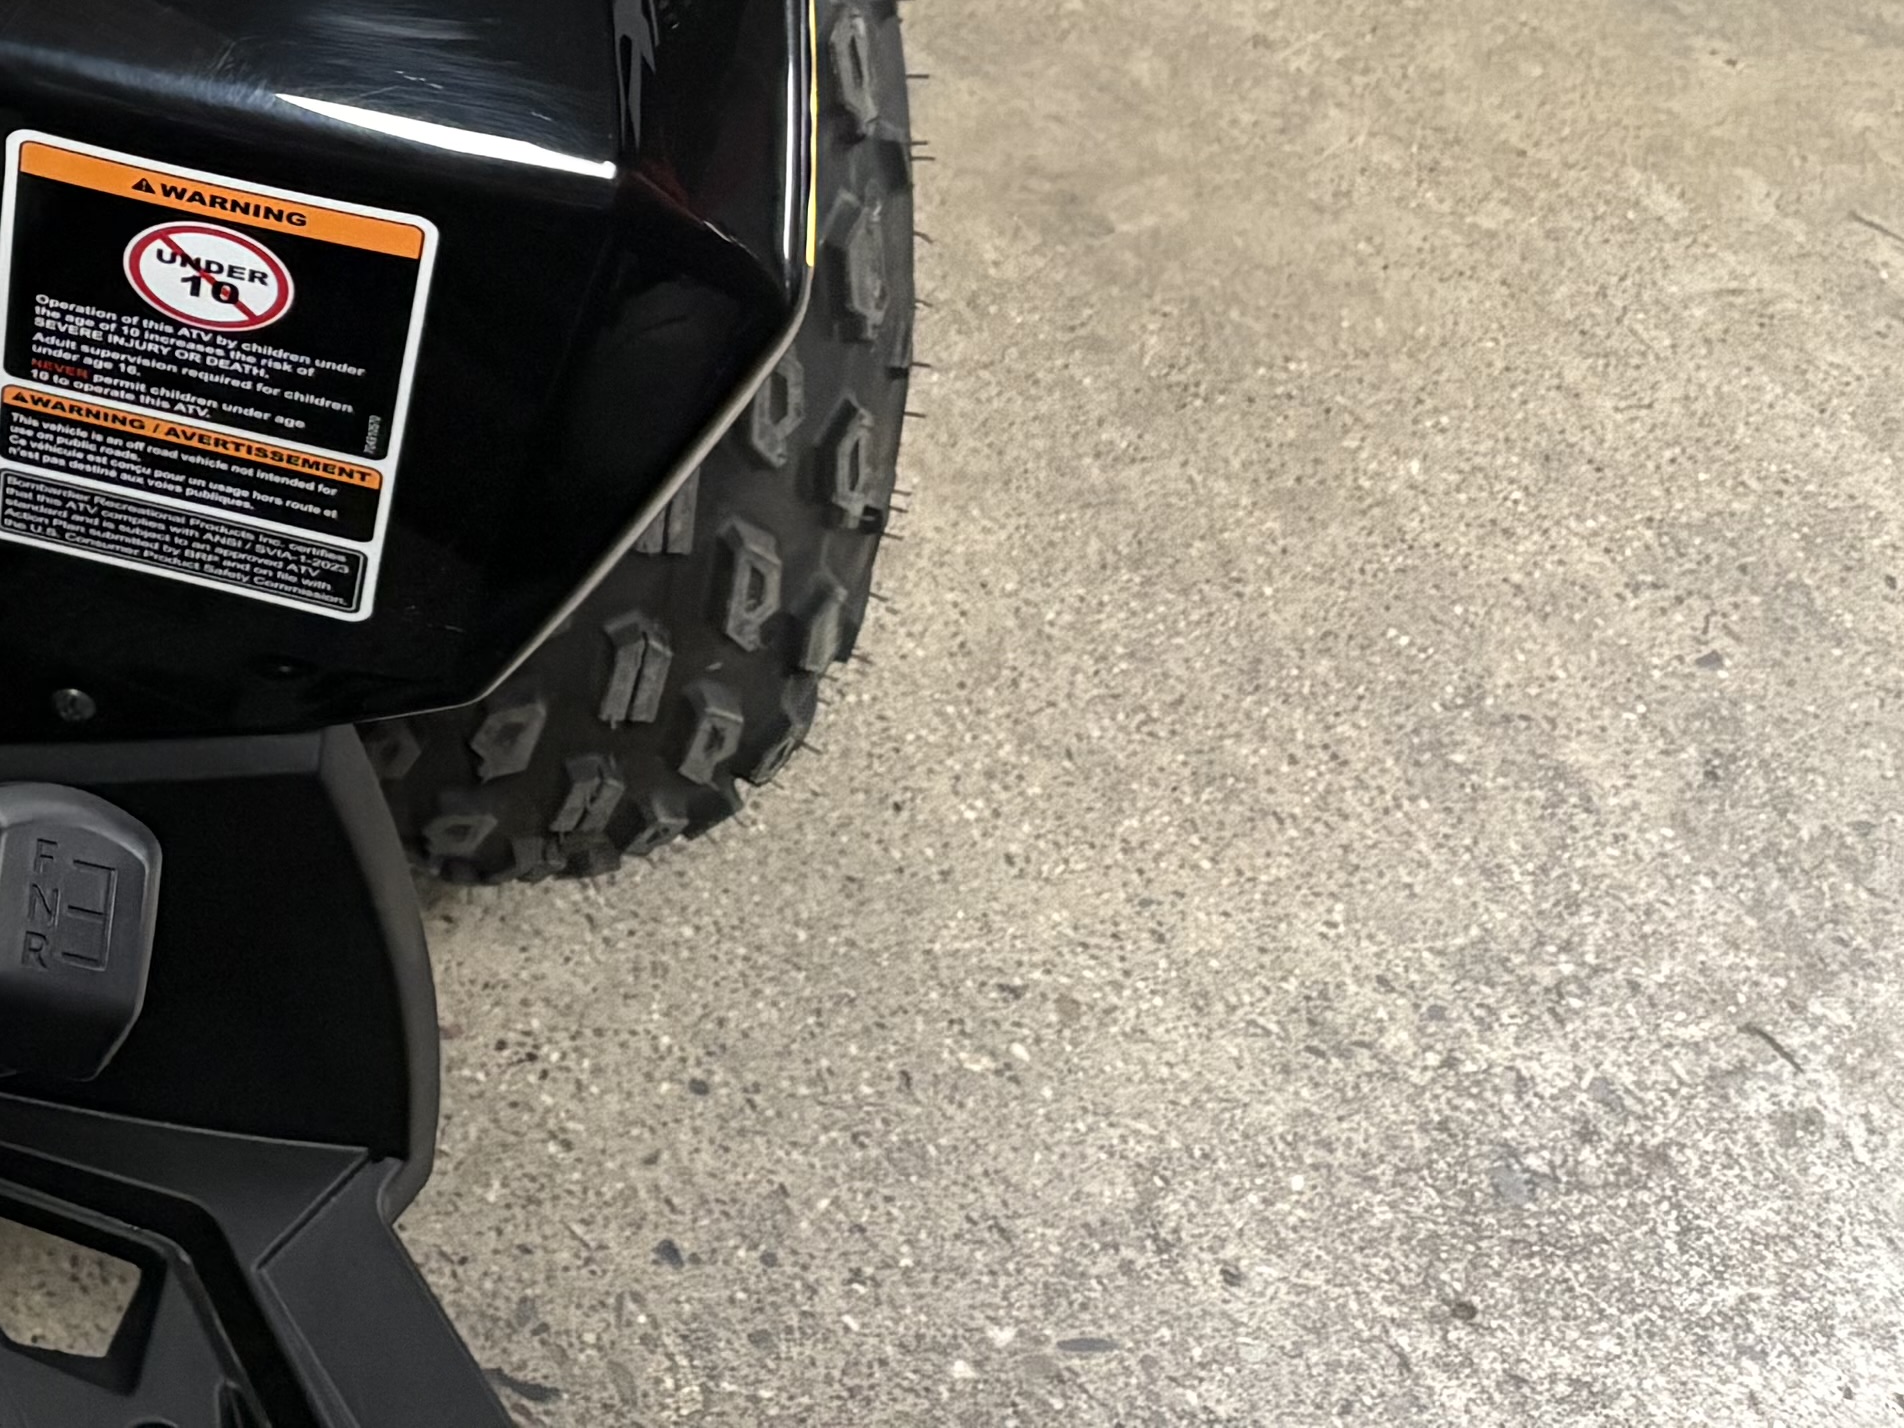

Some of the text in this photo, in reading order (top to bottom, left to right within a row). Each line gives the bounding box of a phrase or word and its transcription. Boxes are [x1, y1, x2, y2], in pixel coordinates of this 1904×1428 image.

[160, 183, 307, 227] WARNING
[156, 248, 268, 286] UNDER
[181, 274, 242, 309] 10
[34, 316, 270, 379] SEVERE INJURY OR DEATH.
[35, 293, 118, 325] Operation
[141, 318, 175, 334] this
[176, 326, 214, 342] ATV
[240, 342, 312, 365] children
[314, 358, 366, 377] under
[32, 331, 354, 413] Adult supervision required for children
[30, 394, 145, 430] WARNING
[165, 427, 370, 482] AVERTISSEMENT
[34, 837, 59, 874] F
[27, 882, 61, 928] N
[20, 929, 50, 971] R
